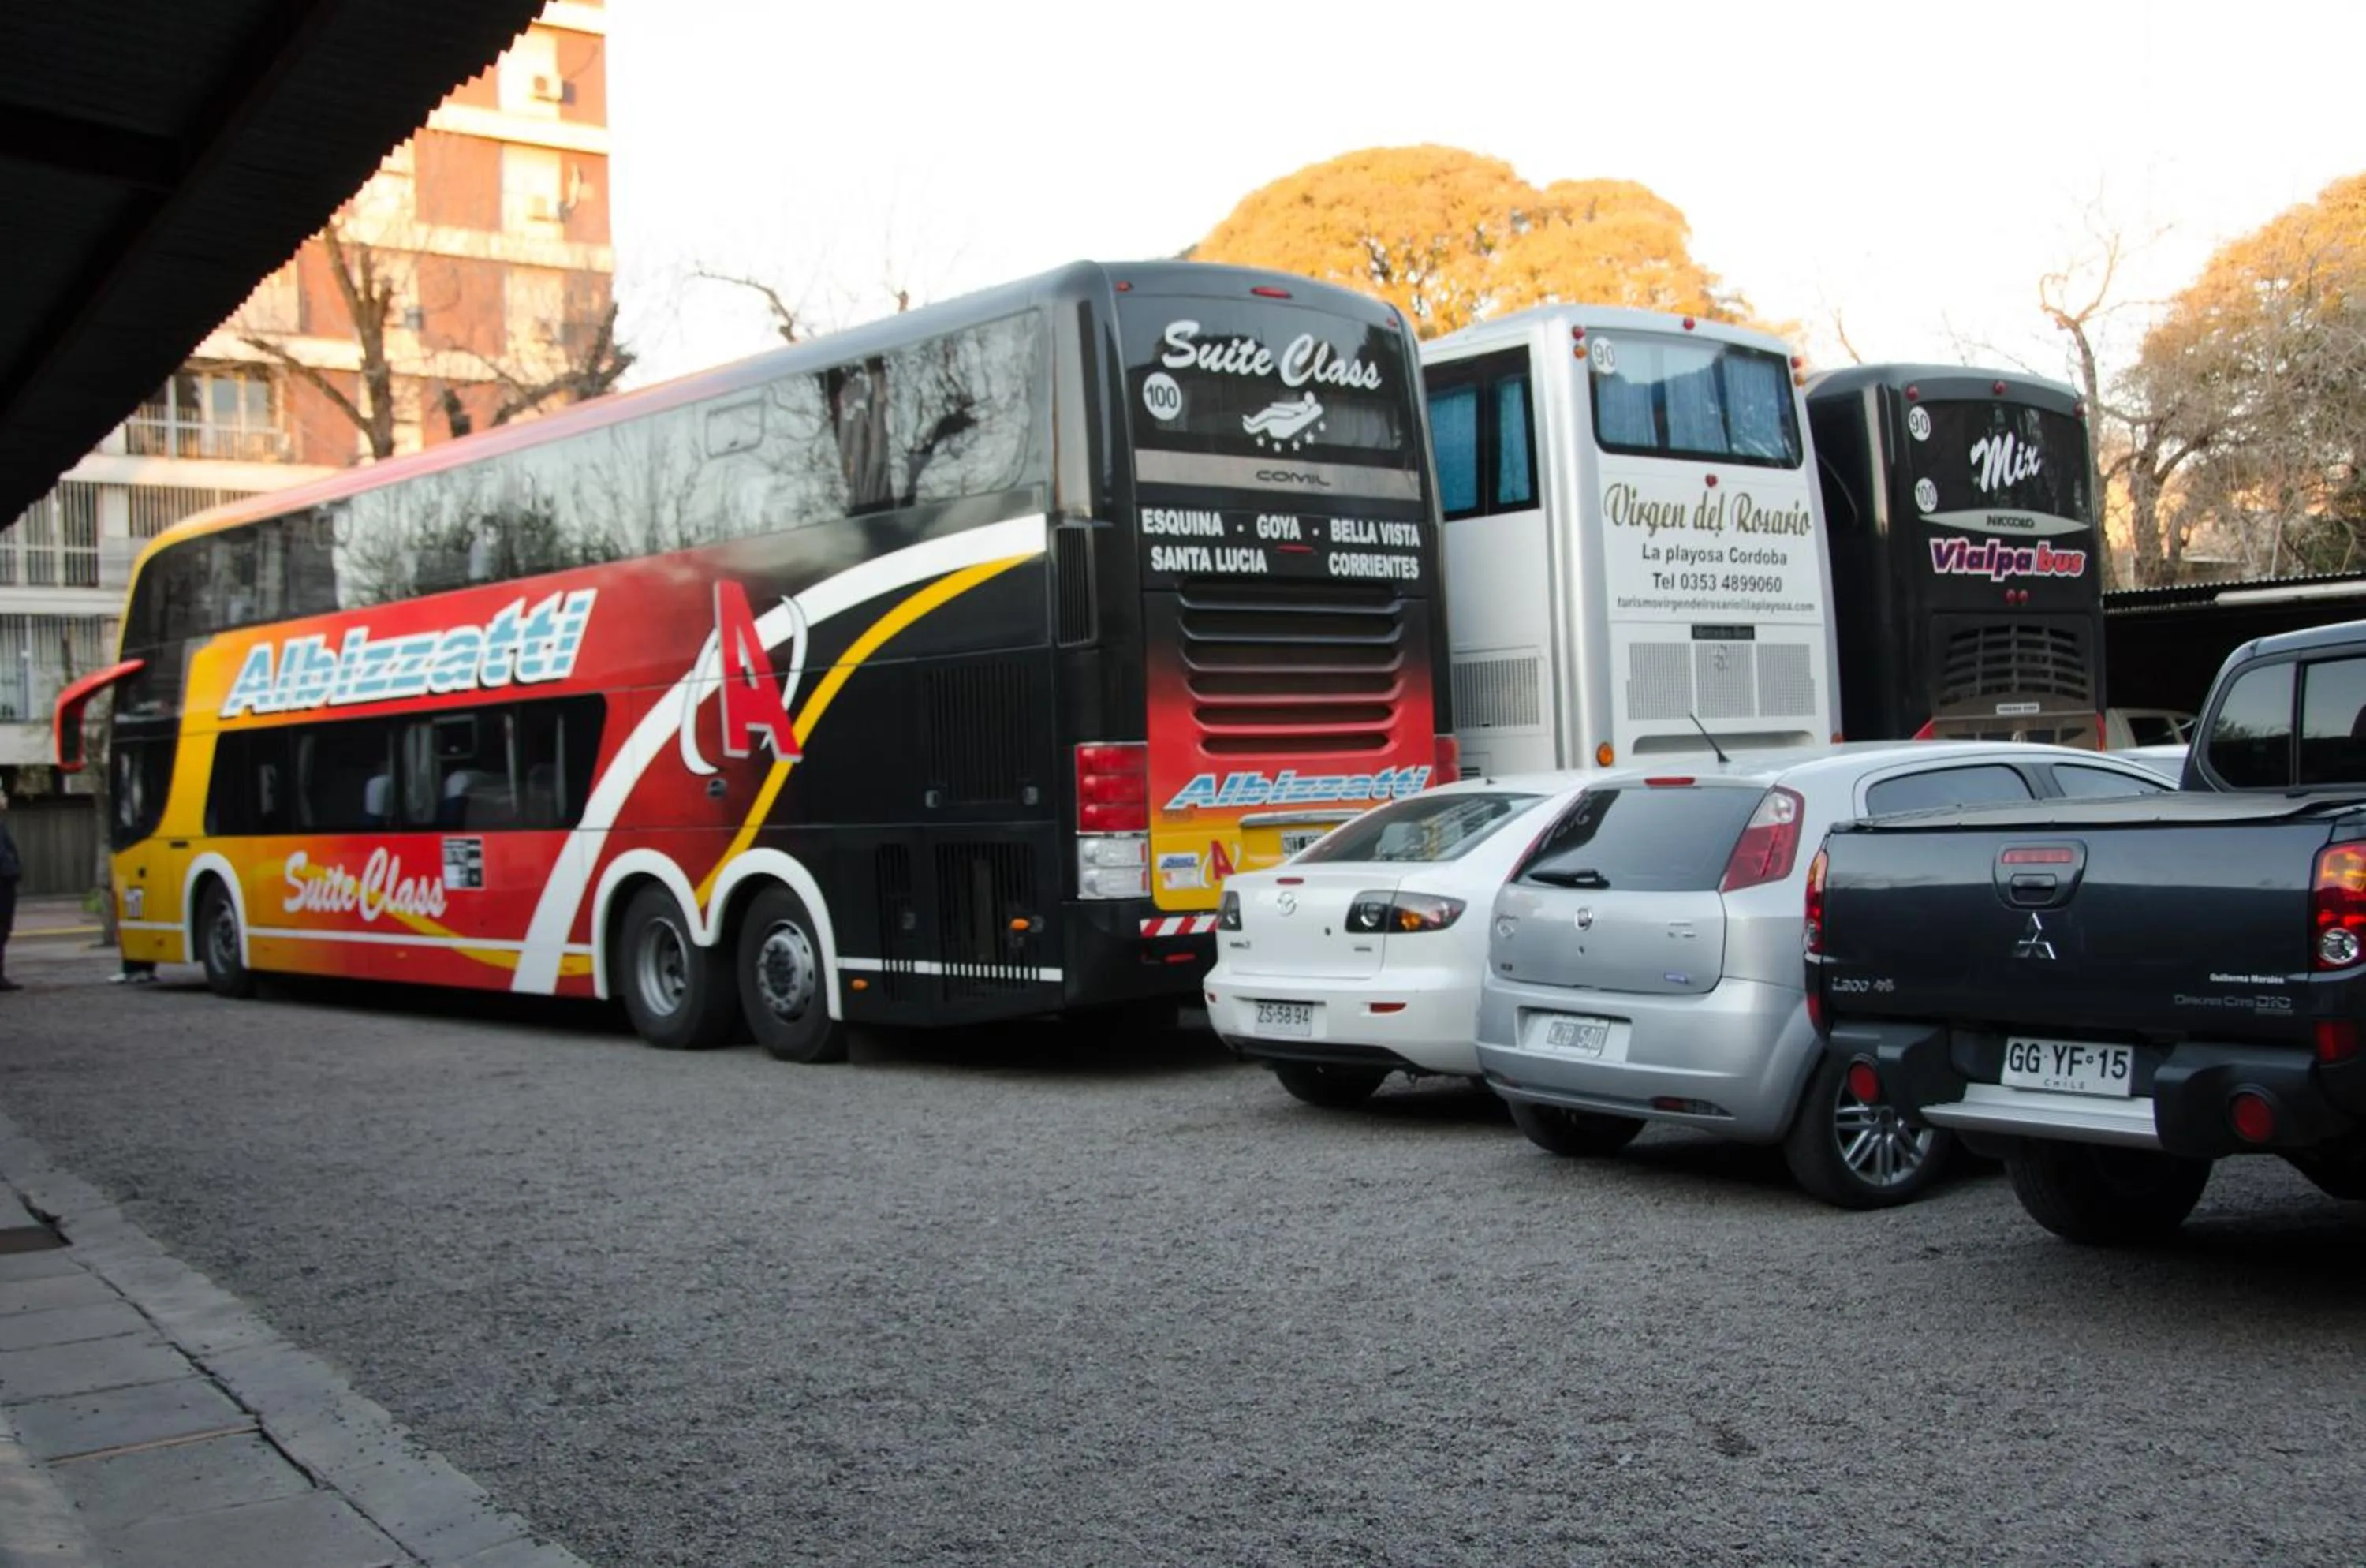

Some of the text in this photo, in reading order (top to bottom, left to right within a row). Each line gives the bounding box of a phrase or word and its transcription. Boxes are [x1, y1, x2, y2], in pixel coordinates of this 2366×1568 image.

[1162, 319, 1382, 390] Suite Class
[1592, 342, 1615, 368] 90
[1147, 384, 1178, 409] 100
[1909, 413, 1929, 435] 90
[1970, 431, 2041, 492] Mix
[1603, 483, 1811, 537] Virgen del Rosario
[1916, 486, 1936, 506] 100
[1141, 509, 1420, 547] ESQUINA GOYA BELLA VISTA
[1151, 546, 1419, 580] SANTA LUCIA CORRIENTES
[1642, 543, 1787, 566] La playosa Cordoba
[1653, 573, 1782, 593] Tel 0353 4899060
[283, 850, 356, 913] Suite
[359, 846, 447, 922] Class
